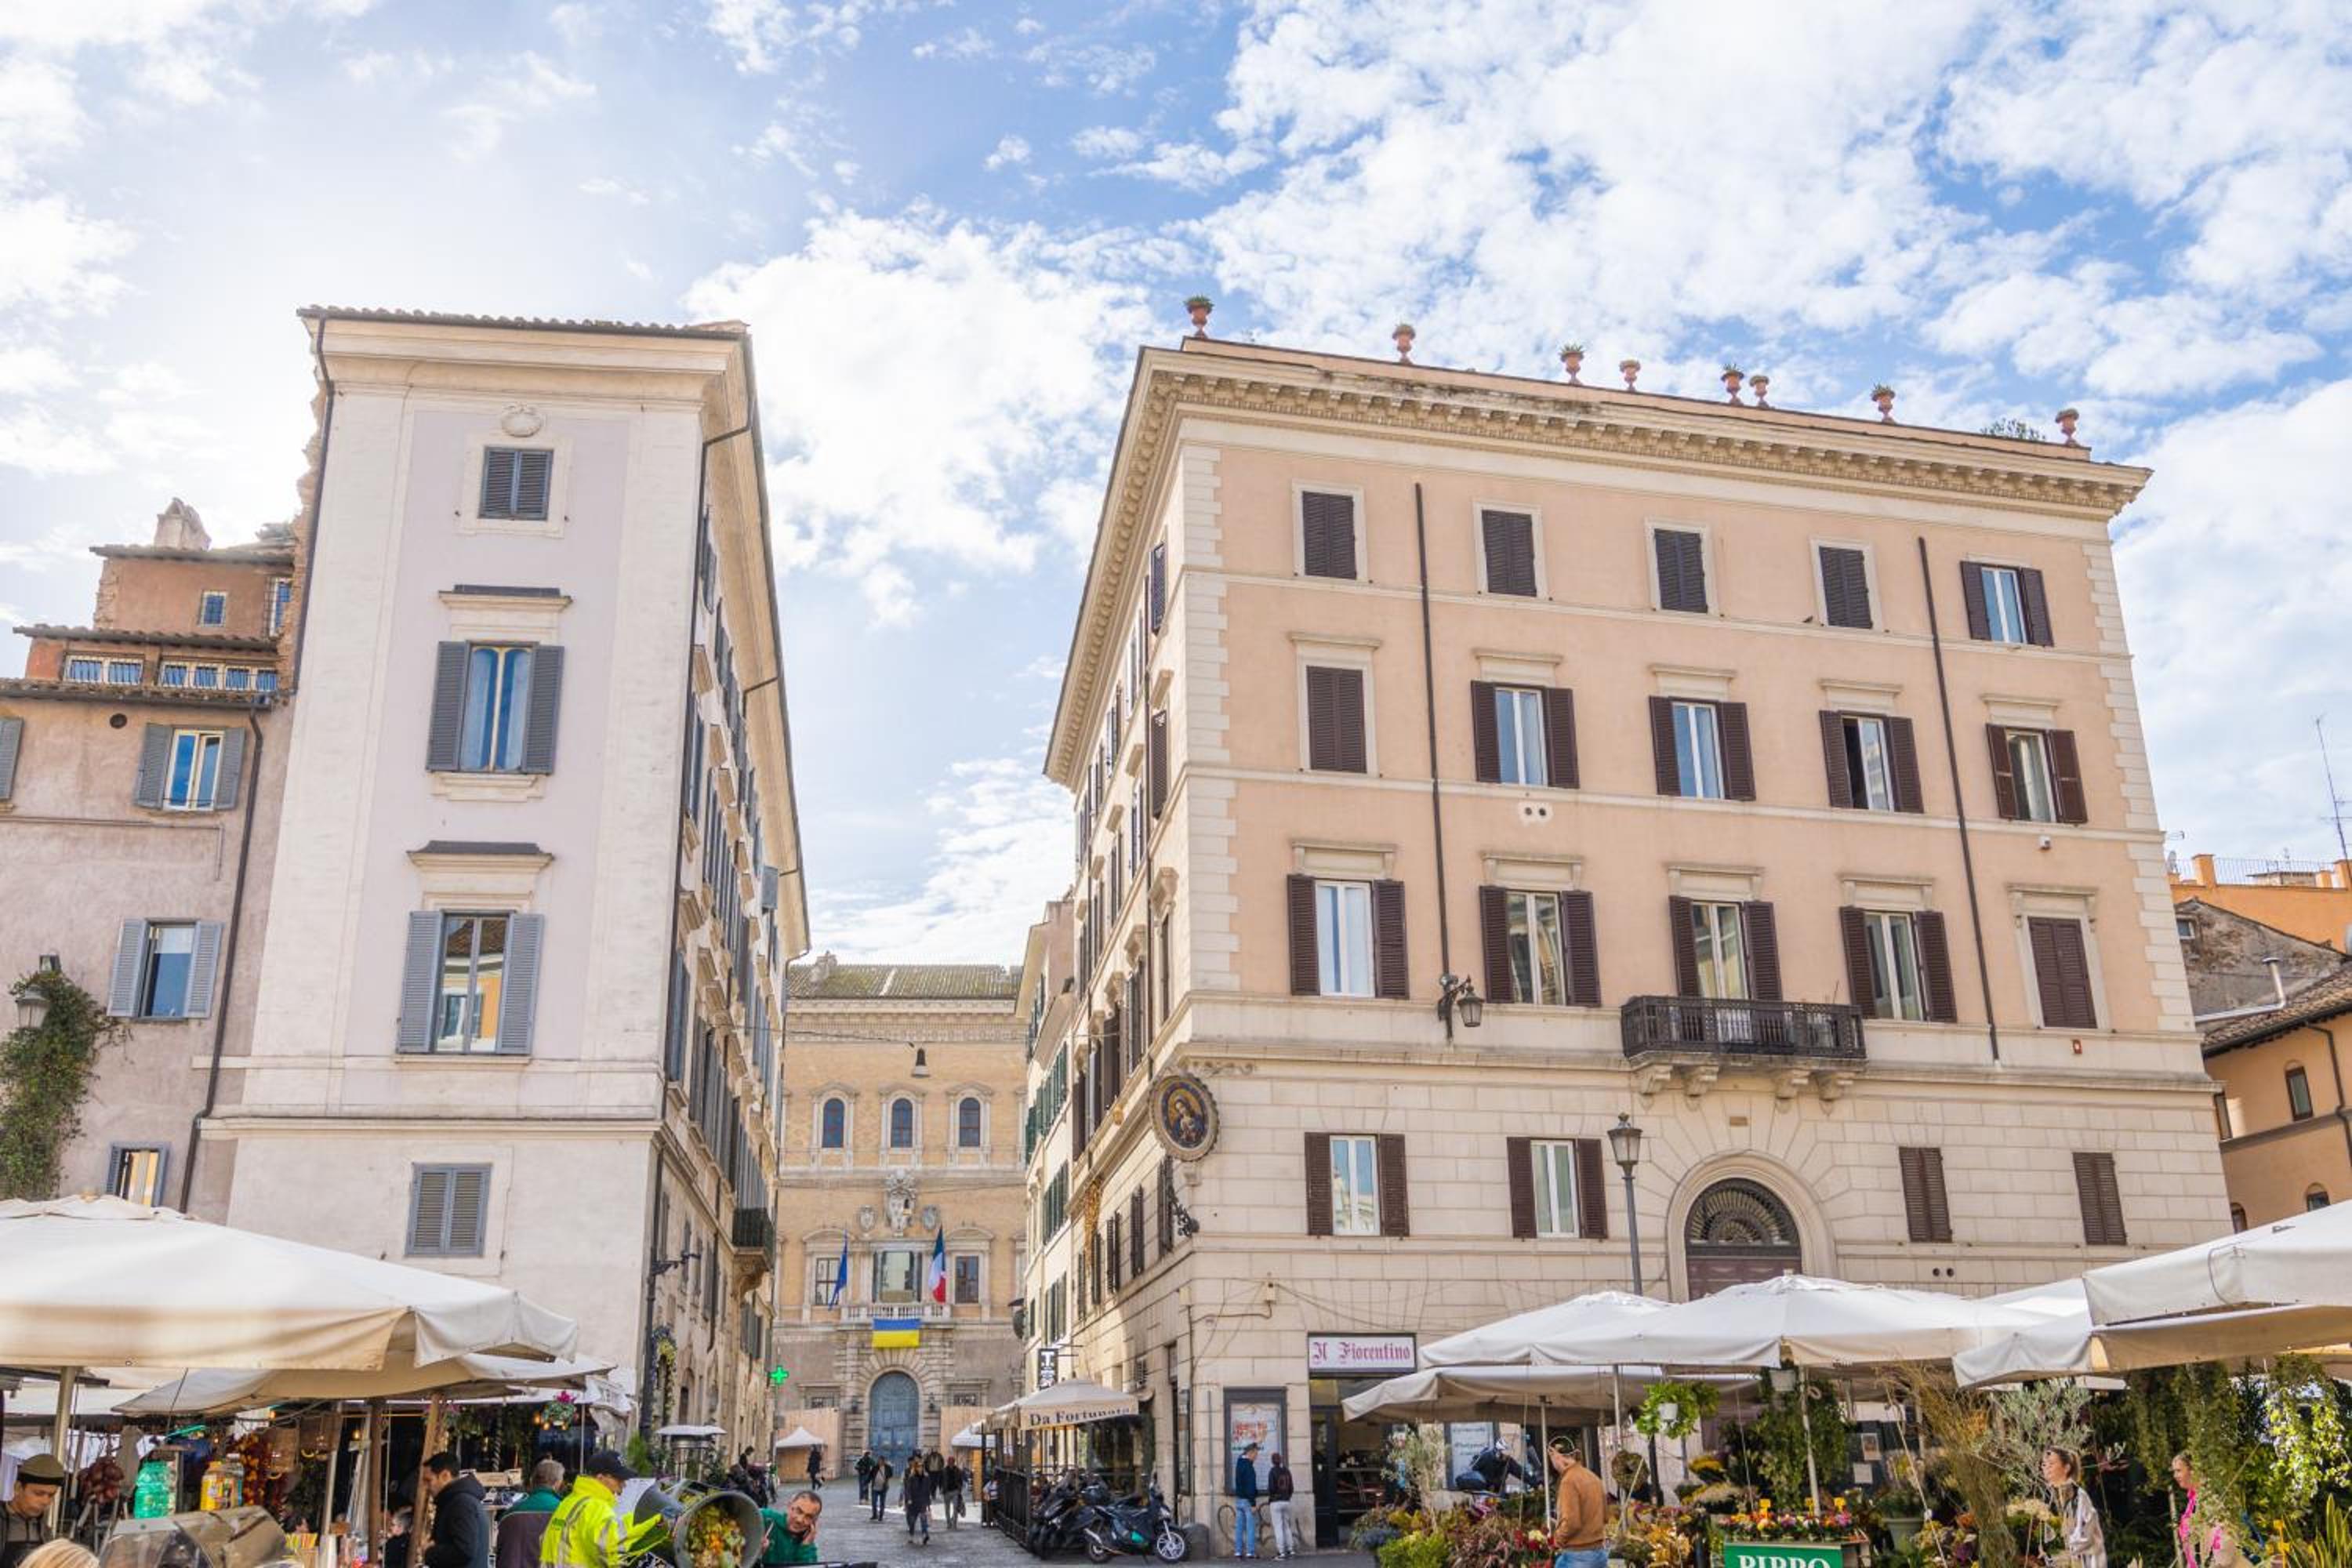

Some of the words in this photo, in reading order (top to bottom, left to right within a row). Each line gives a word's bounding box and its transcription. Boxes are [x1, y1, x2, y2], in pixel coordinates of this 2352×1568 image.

[1313, 1341, 1327, 1363] Il
[1339, 1341, 1410, 1363] Fiorentino
[1029, 1413, 1050, 1426] Da
